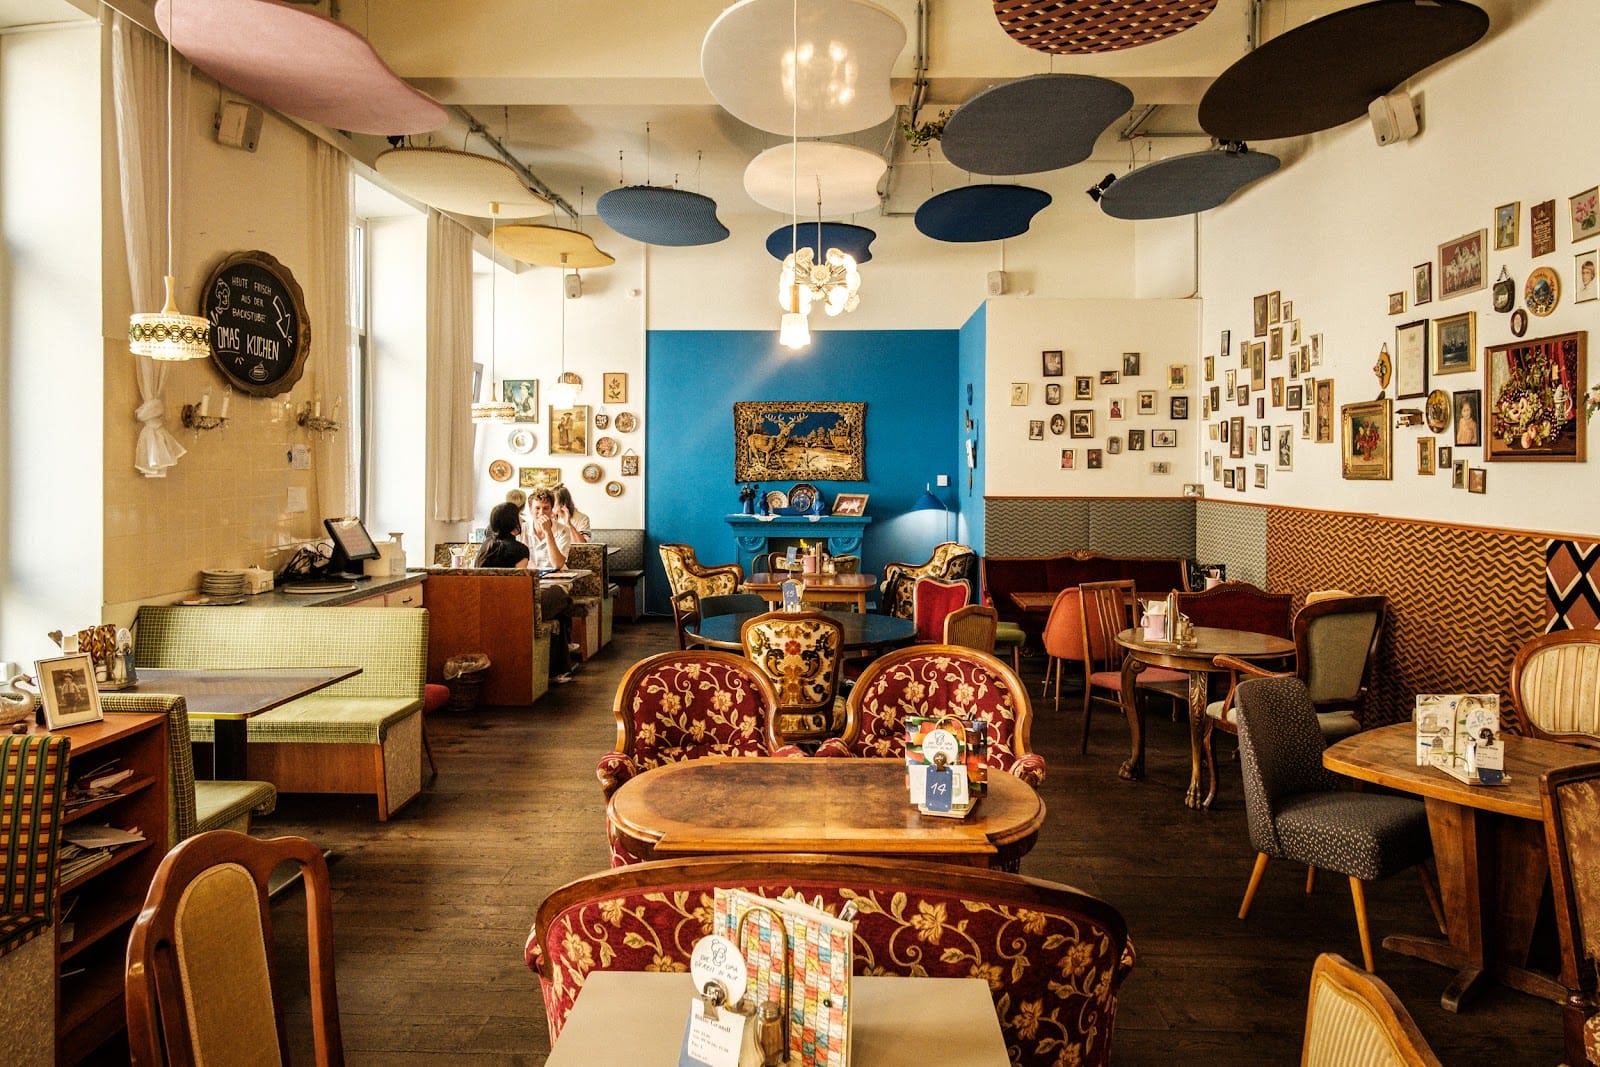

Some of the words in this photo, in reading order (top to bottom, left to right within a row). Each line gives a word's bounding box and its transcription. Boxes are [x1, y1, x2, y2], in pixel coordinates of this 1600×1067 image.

[232, 276, 249, 289] HEUTE
[254, 282, 272, 296] FRISCH
[240, 295, 252, 304] AUS
[253, 297, 264, 307] DER
[217, 326, 240, 351] OMAS
[247, 334, 279, 361] KUCHEN
[931, 783, 946, 796] 14
